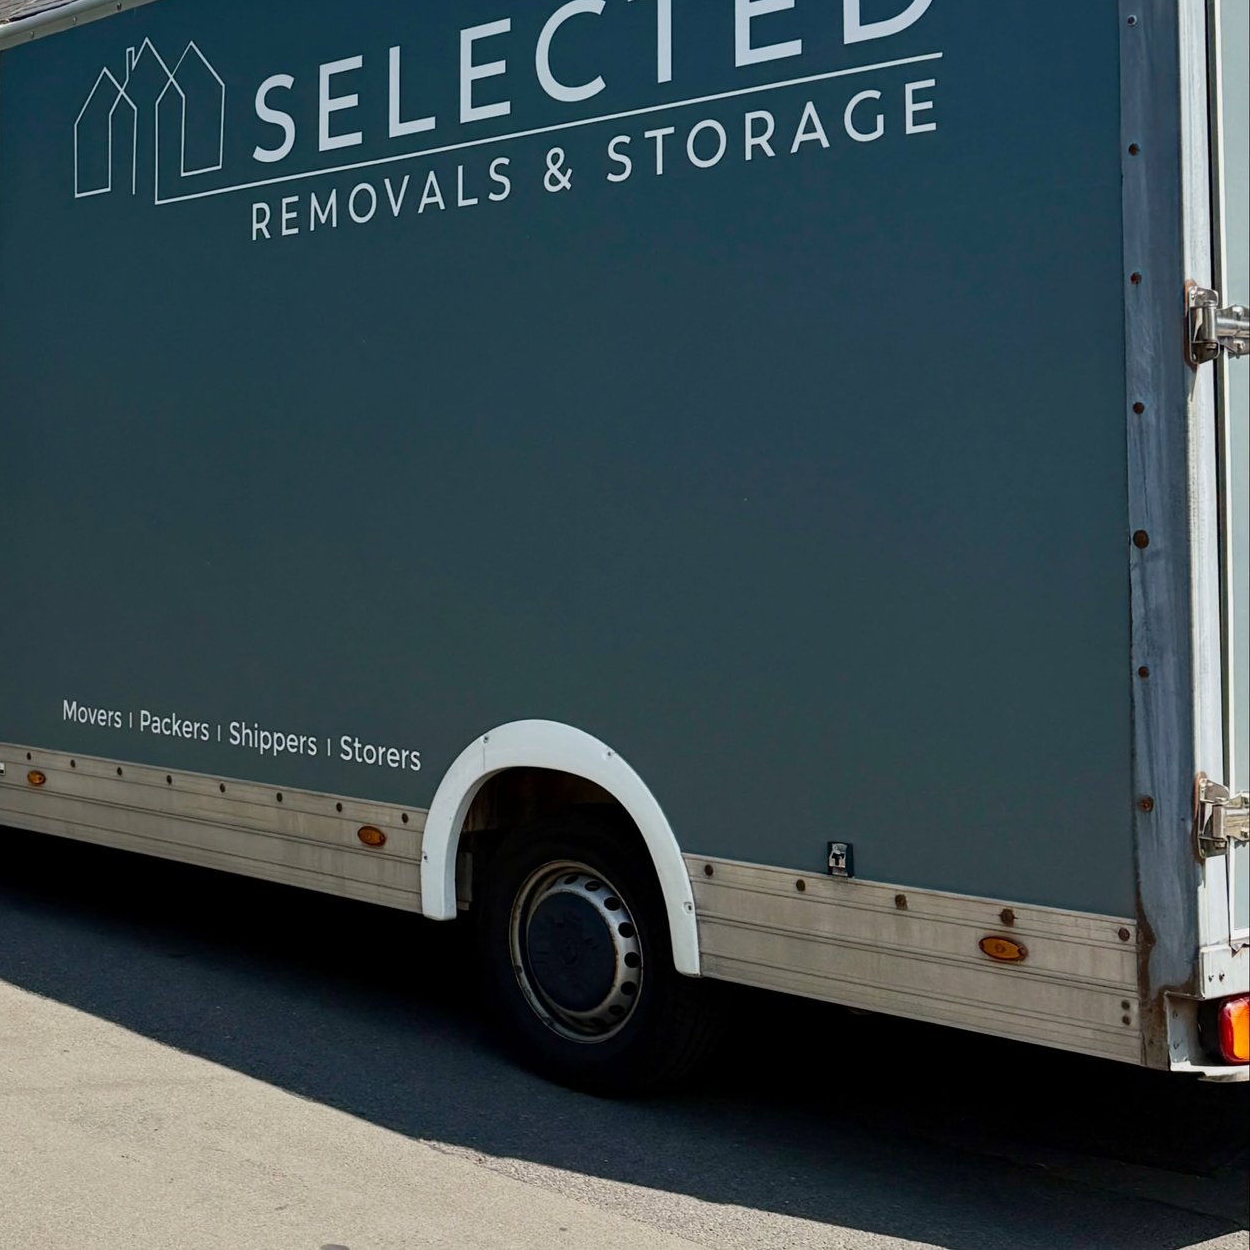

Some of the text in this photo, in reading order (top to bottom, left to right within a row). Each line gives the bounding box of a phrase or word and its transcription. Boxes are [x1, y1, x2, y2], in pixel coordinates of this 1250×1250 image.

[252, 79, 937, 241] REMOVALS & STORAGE
[63, 700, 422, 772] Movers Packers Shippers Storers
